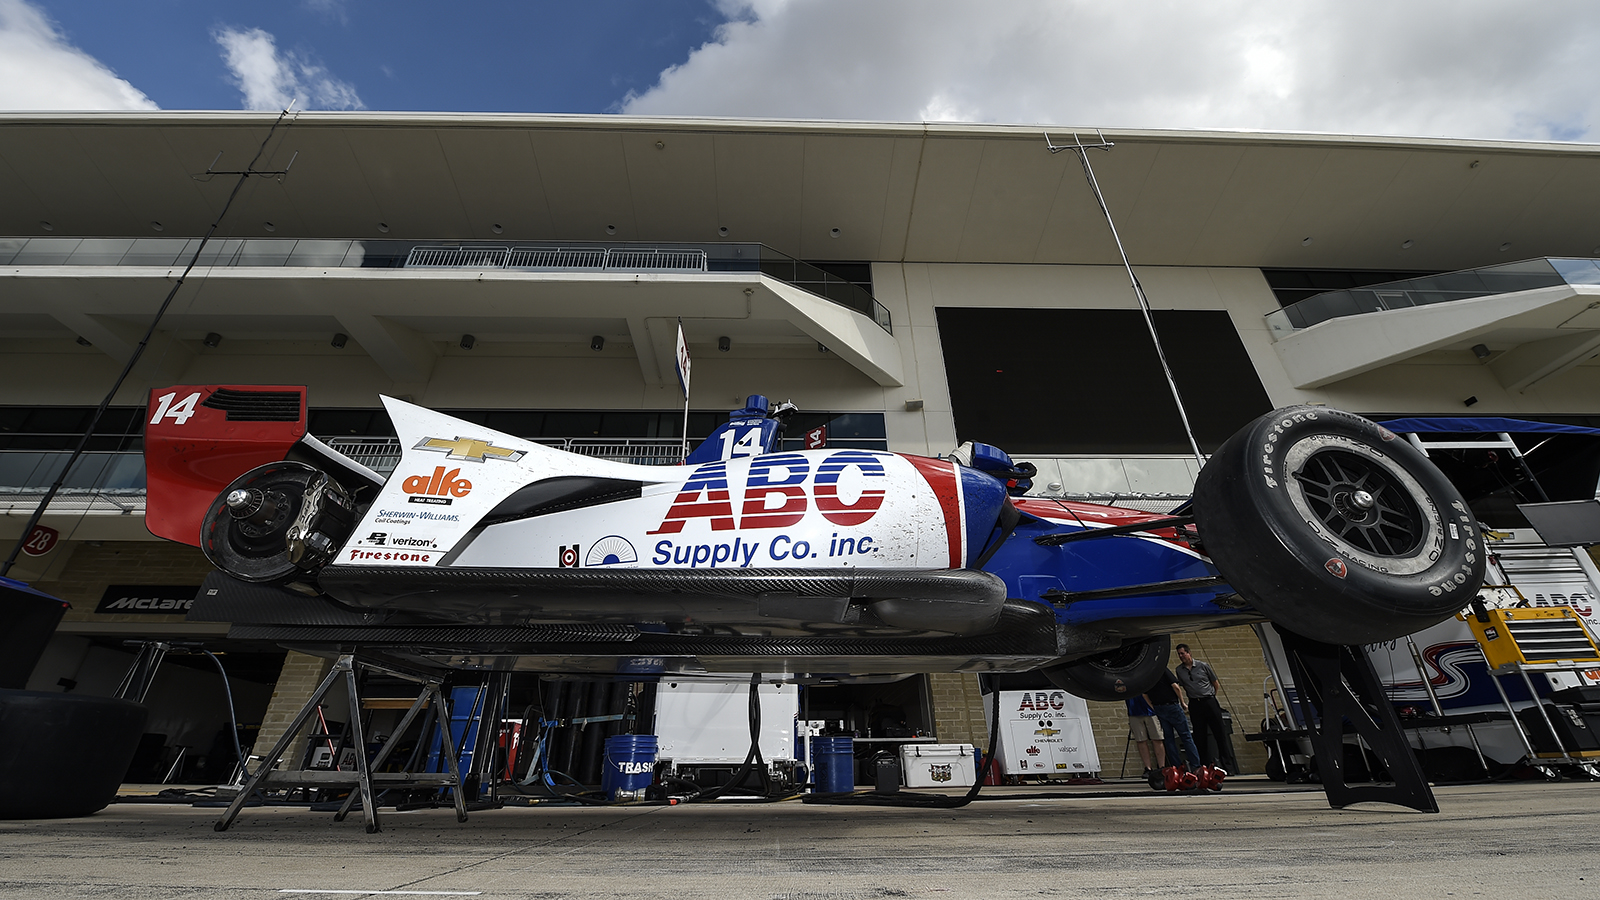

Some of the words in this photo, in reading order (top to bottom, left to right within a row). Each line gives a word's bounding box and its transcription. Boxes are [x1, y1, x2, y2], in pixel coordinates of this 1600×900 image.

[150, 392, 201, 425] 14
[720, 427, 764, 461] 14
[809, 429, 822, 449] 14
[1262, 412, 1318, 489] Firestone
[401, 466, 473, 498] alfe
[646, 451, 894, 535] ABC
[1425, 496, 1443, 536] RACING
[27, 529, 52, 551] 28
[392, 537, 430, 548] verizon
[652, 537, 760, 568] Supply
[769, 534, 818, 560] Co.
[829, 533, 880, 557] inc.
[1428, 499, 1477, 597] Firestone
[350, 549, 430, 563] Firestone
[1342, 550, 1389, 573] RACING
[105, 597, 195, 610] McLare
[1017, 691, 1065, 711] ABC
[1020, 712, 1042, 720] Supply
[618, 761, 654, 774] TRASH
